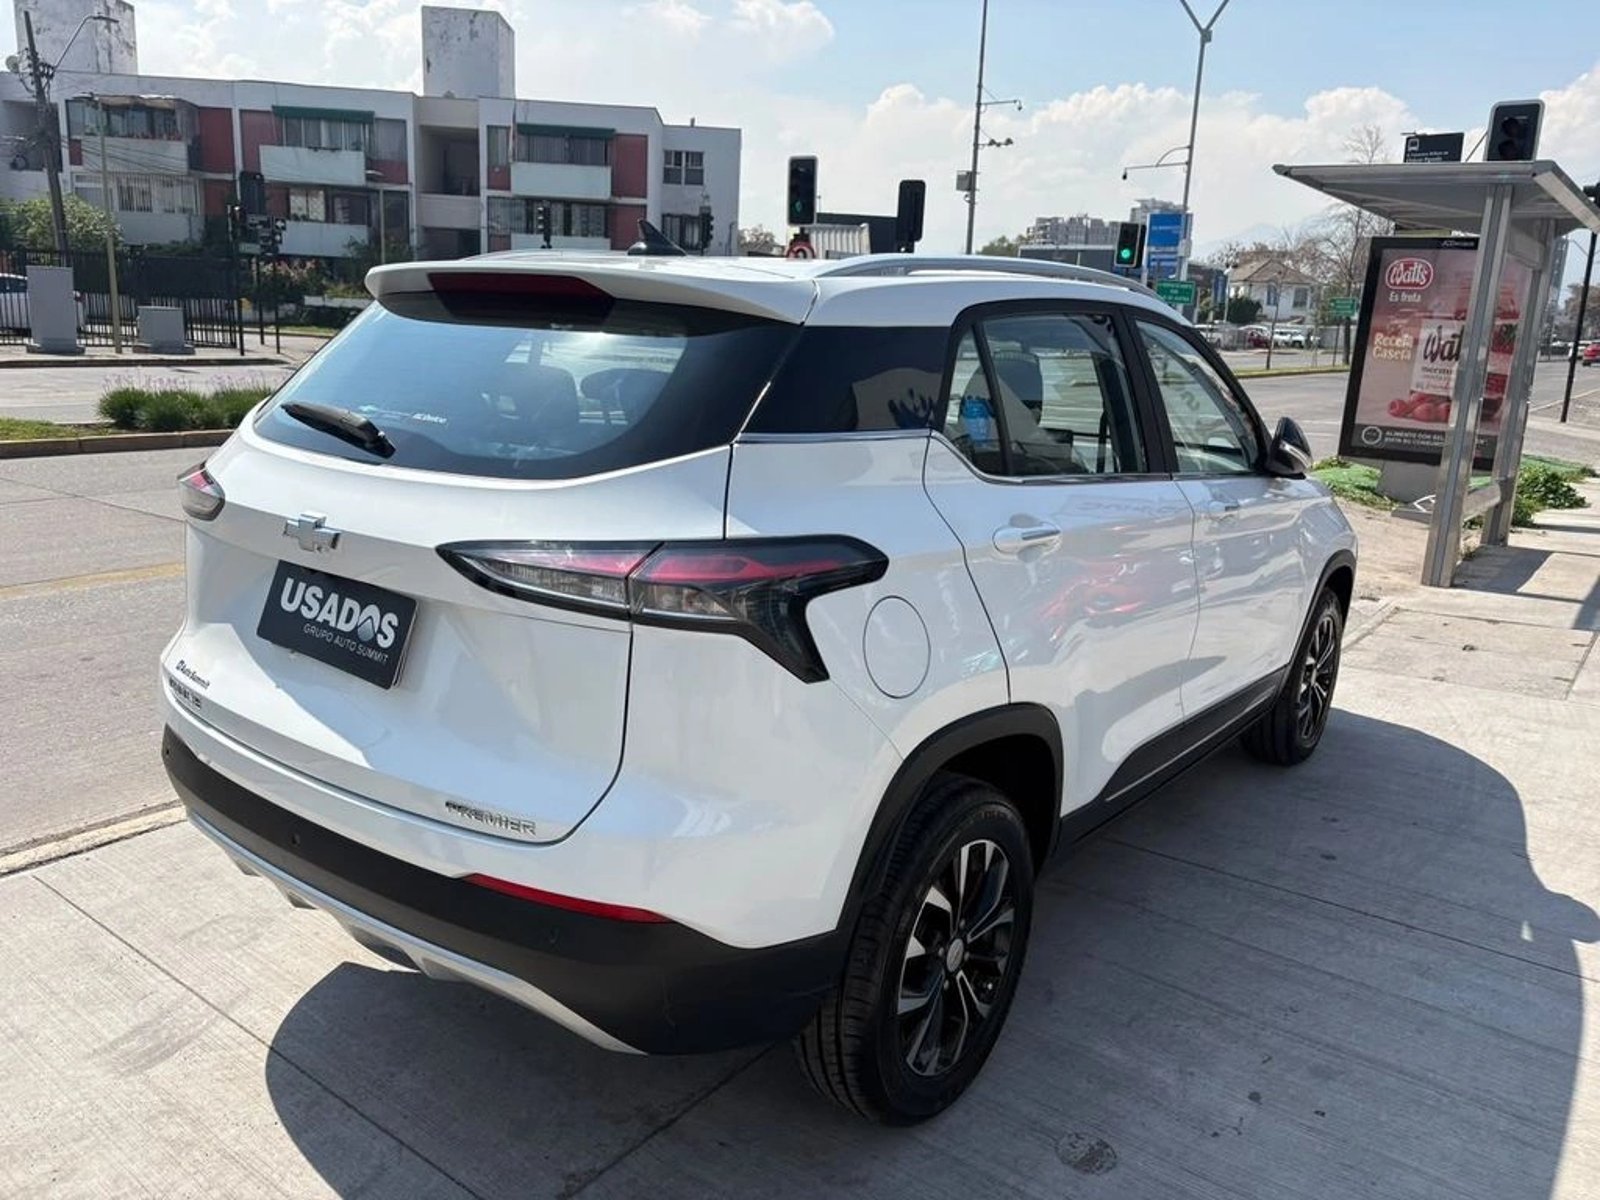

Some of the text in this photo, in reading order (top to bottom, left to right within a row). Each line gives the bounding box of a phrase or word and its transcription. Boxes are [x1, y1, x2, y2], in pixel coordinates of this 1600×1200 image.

[280, 577, 399, 649] USADOS
[303, 622, 389, 664] GRUPO AUTO SUMMIT
[445, 801, 537, 836] PREMIER
